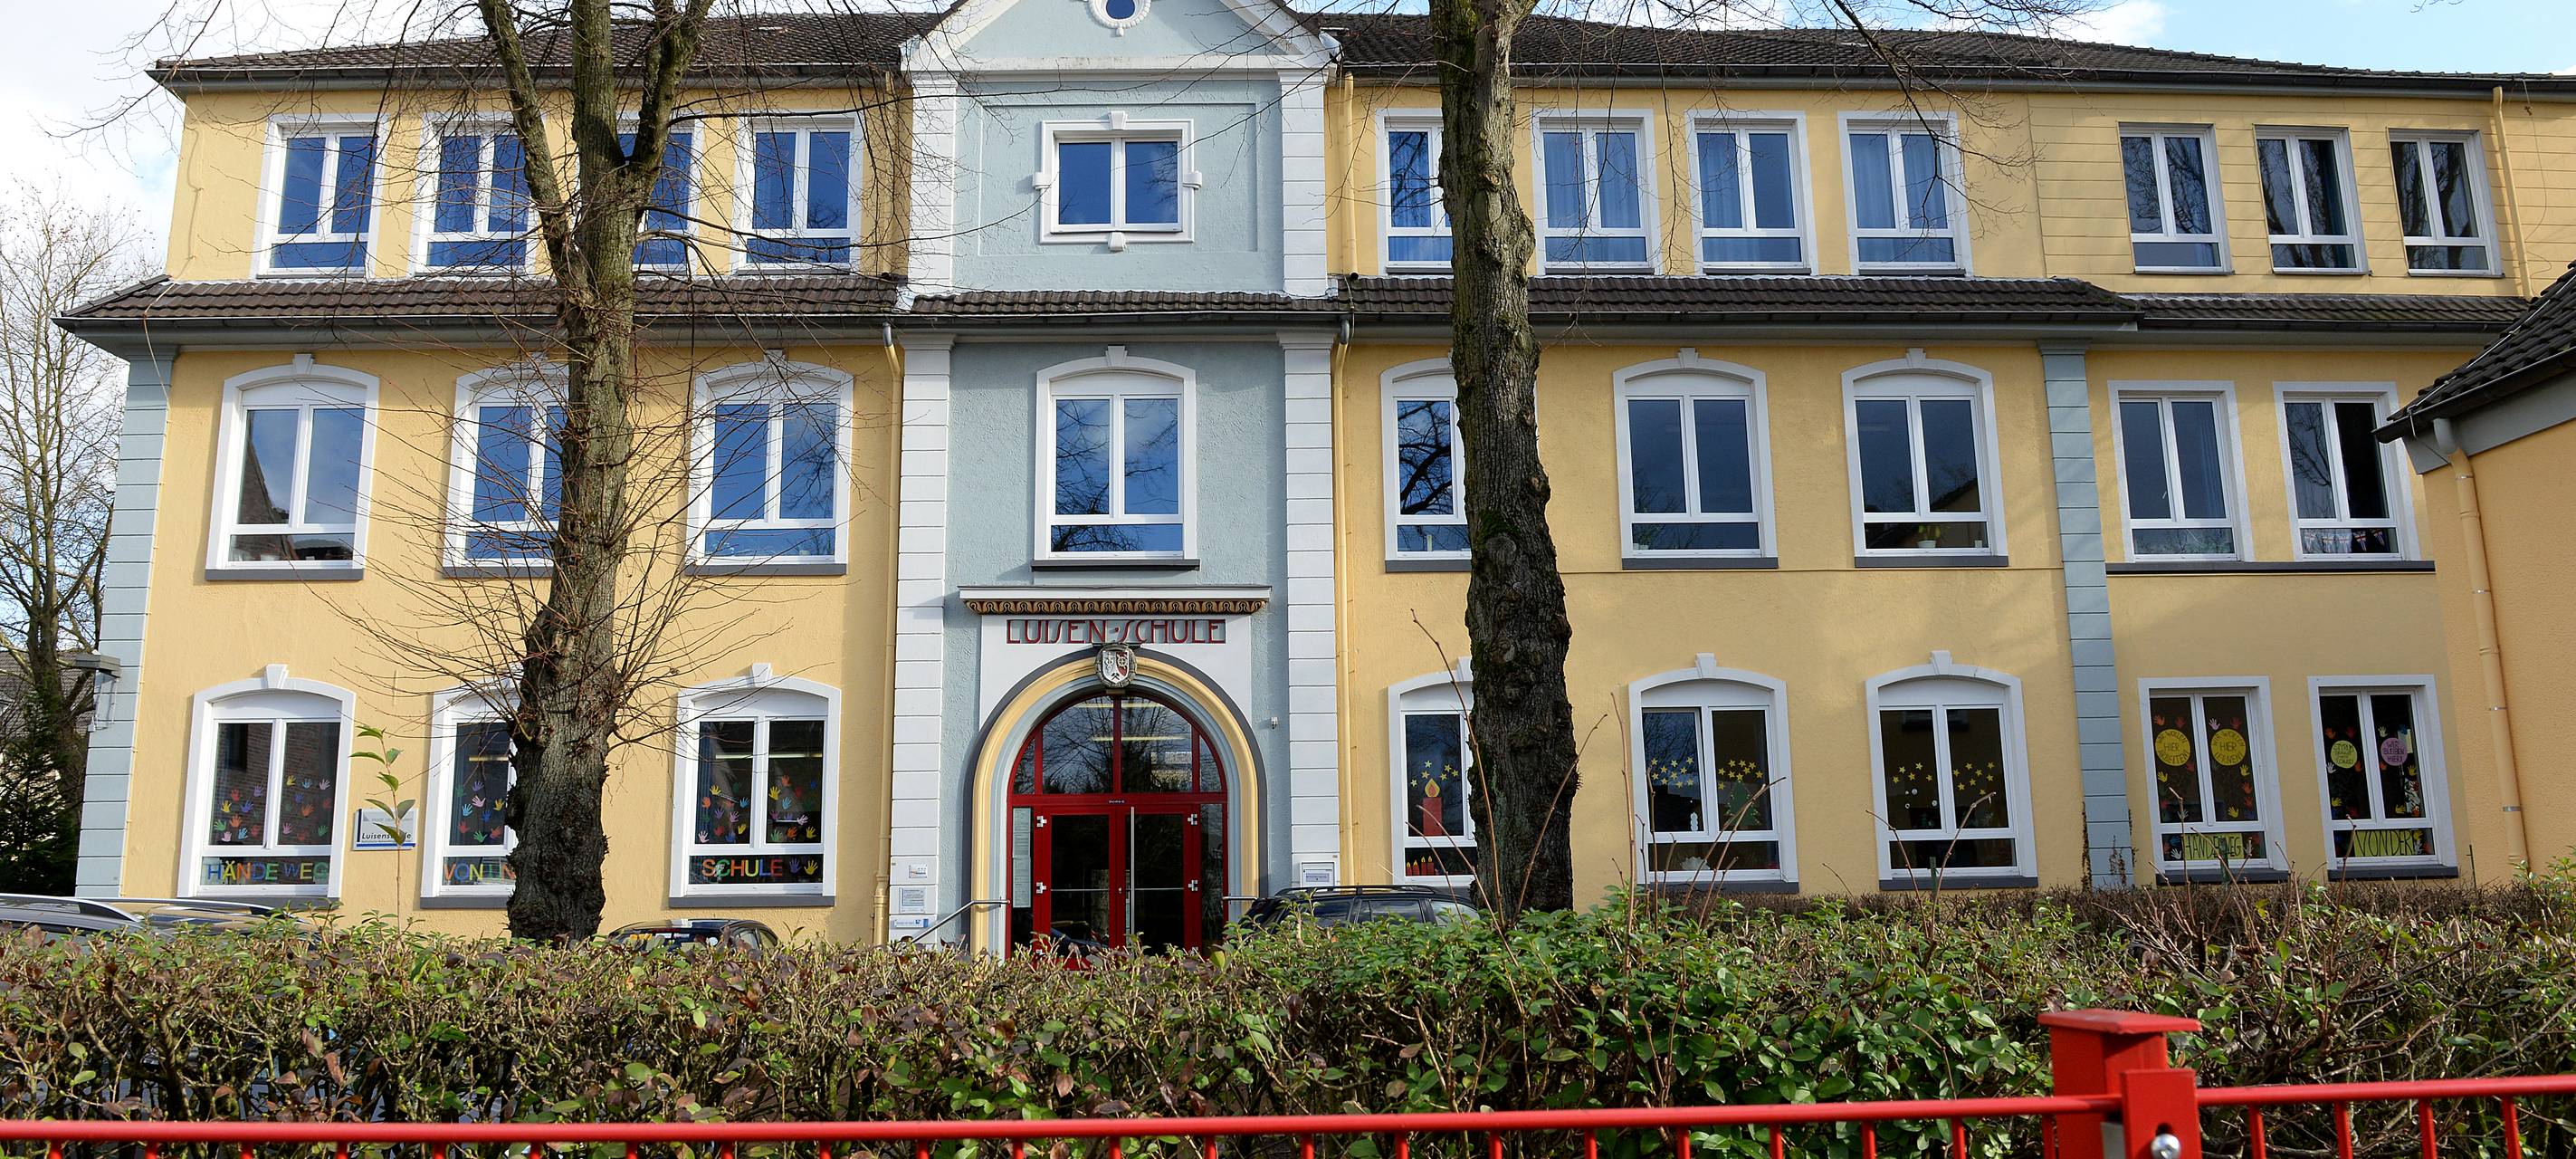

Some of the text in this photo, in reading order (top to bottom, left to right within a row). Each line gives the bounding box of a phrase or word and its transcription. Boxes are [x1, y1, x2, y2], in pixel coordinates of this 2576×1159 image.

[207, 860, 329, 881] HÄNDE WEG
[444, 863, 484, 882] VON
[701, 858, 783, 877] SCHULE
